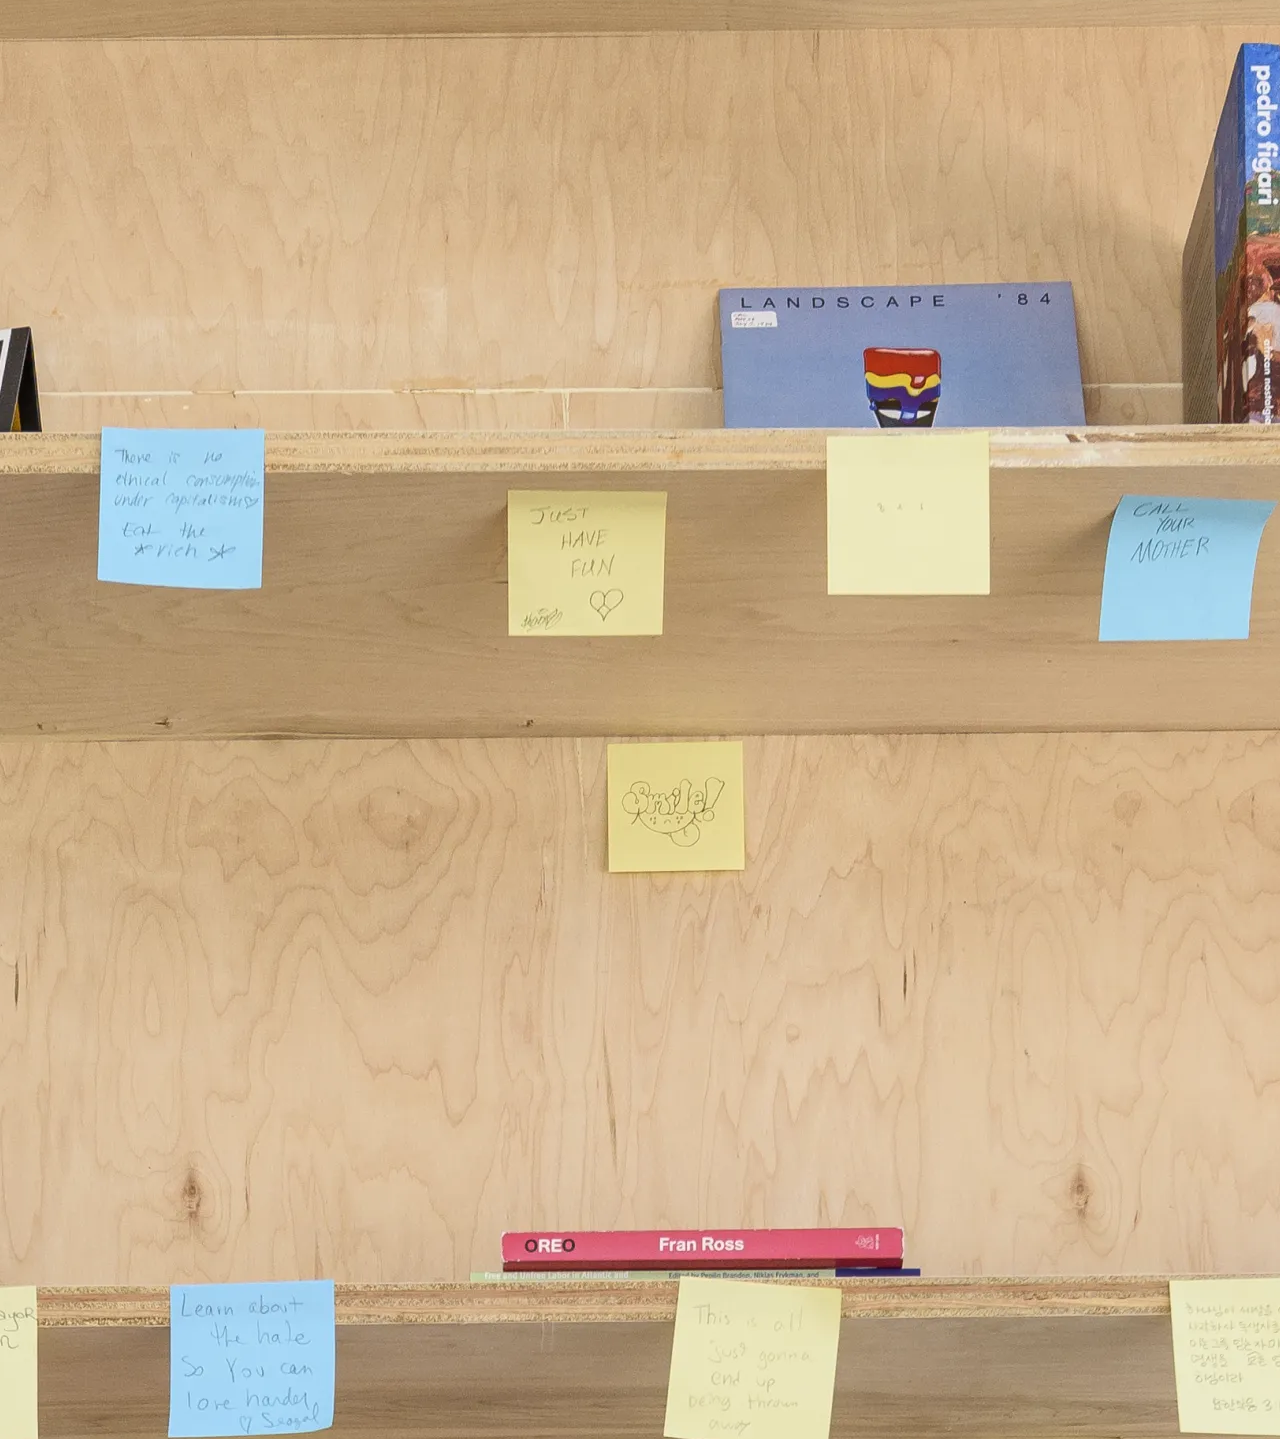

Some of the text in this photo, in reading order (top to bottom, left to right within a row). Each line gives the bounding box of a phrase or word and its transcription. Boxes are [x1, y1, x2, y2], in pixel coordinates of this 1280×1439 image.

[1251, 65, 1279, 206] pedro figari
[741, 293, 1051, 309] LANDSCAPE '84
[1133, 502, 1189, 517] CALL
[1157, 517, 1195, 535] YOUR
[1130, 536, 1210, 564] MOTHER
[524, 1237, 744, 1254] OREO Fran Ross
